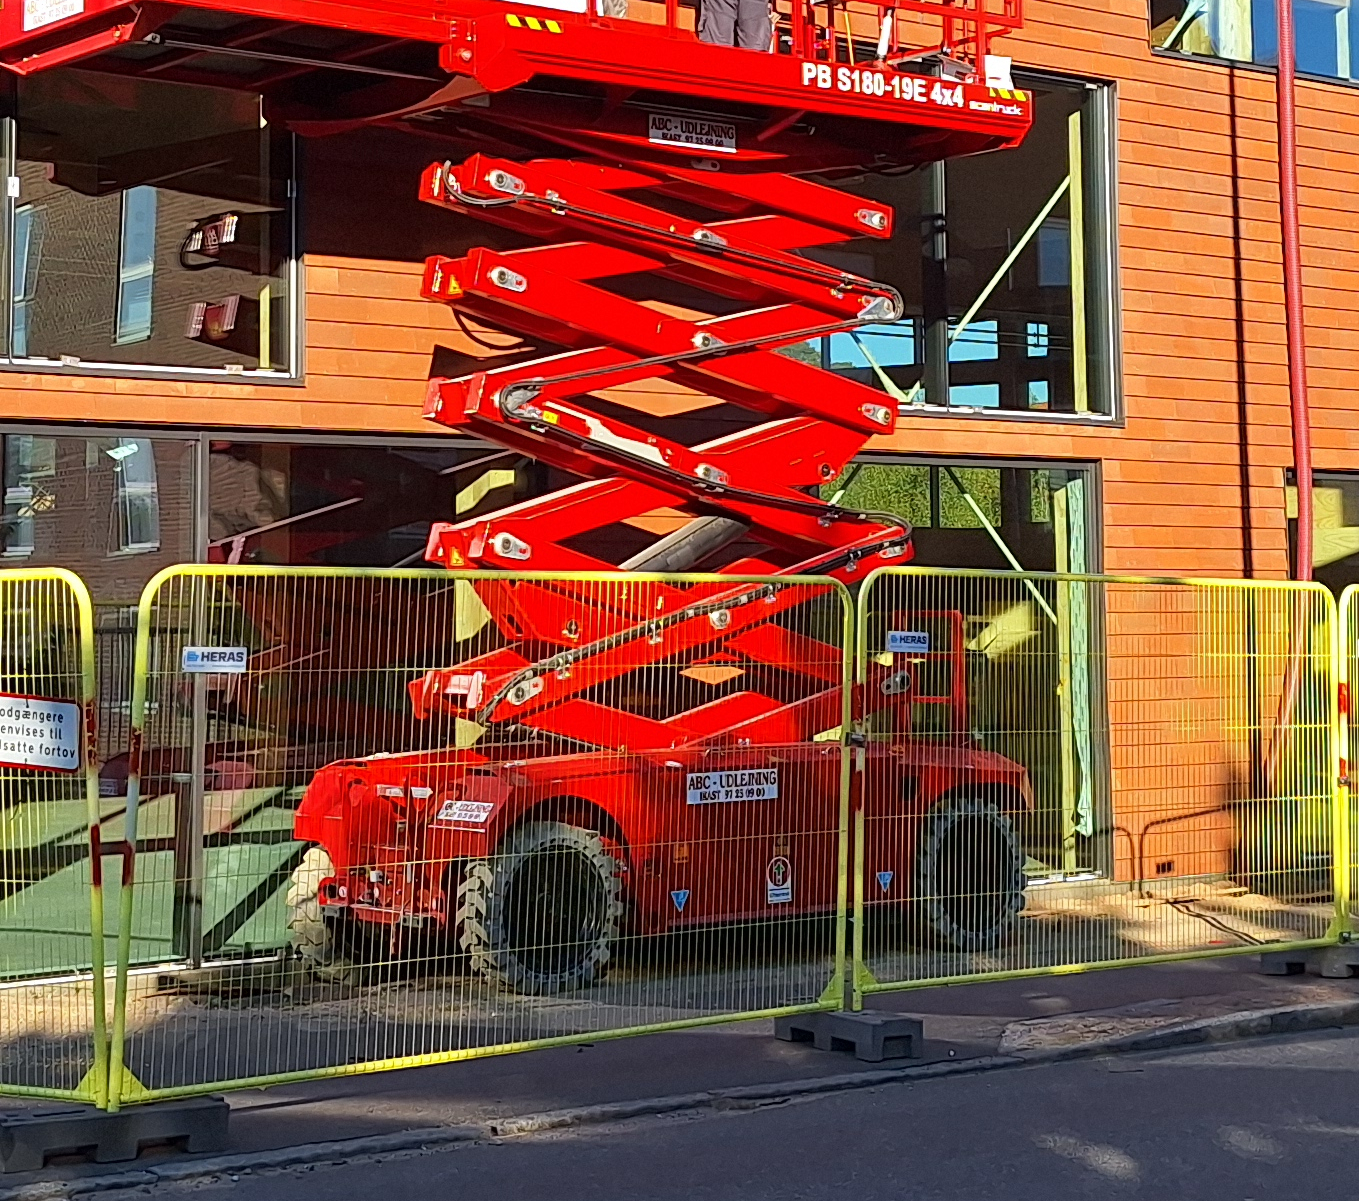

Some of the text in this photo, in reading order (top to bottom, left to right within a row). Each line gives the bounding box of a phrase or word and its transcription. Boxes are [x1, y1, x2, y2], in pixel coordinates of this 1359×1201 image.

[802, 62, 965, 108] PB S180-19E 4x4
[651, 117, 672, 132] ABC
[680, 120, 734, 140] UDLEJNING
[899, 635, 927, 644] HERAS
[201, 652, 244, 662] HERAS
[50, 728, 62, 740] til
[39, 743, 76, 759] fortov
[689, 775, 711, 790] ABC
